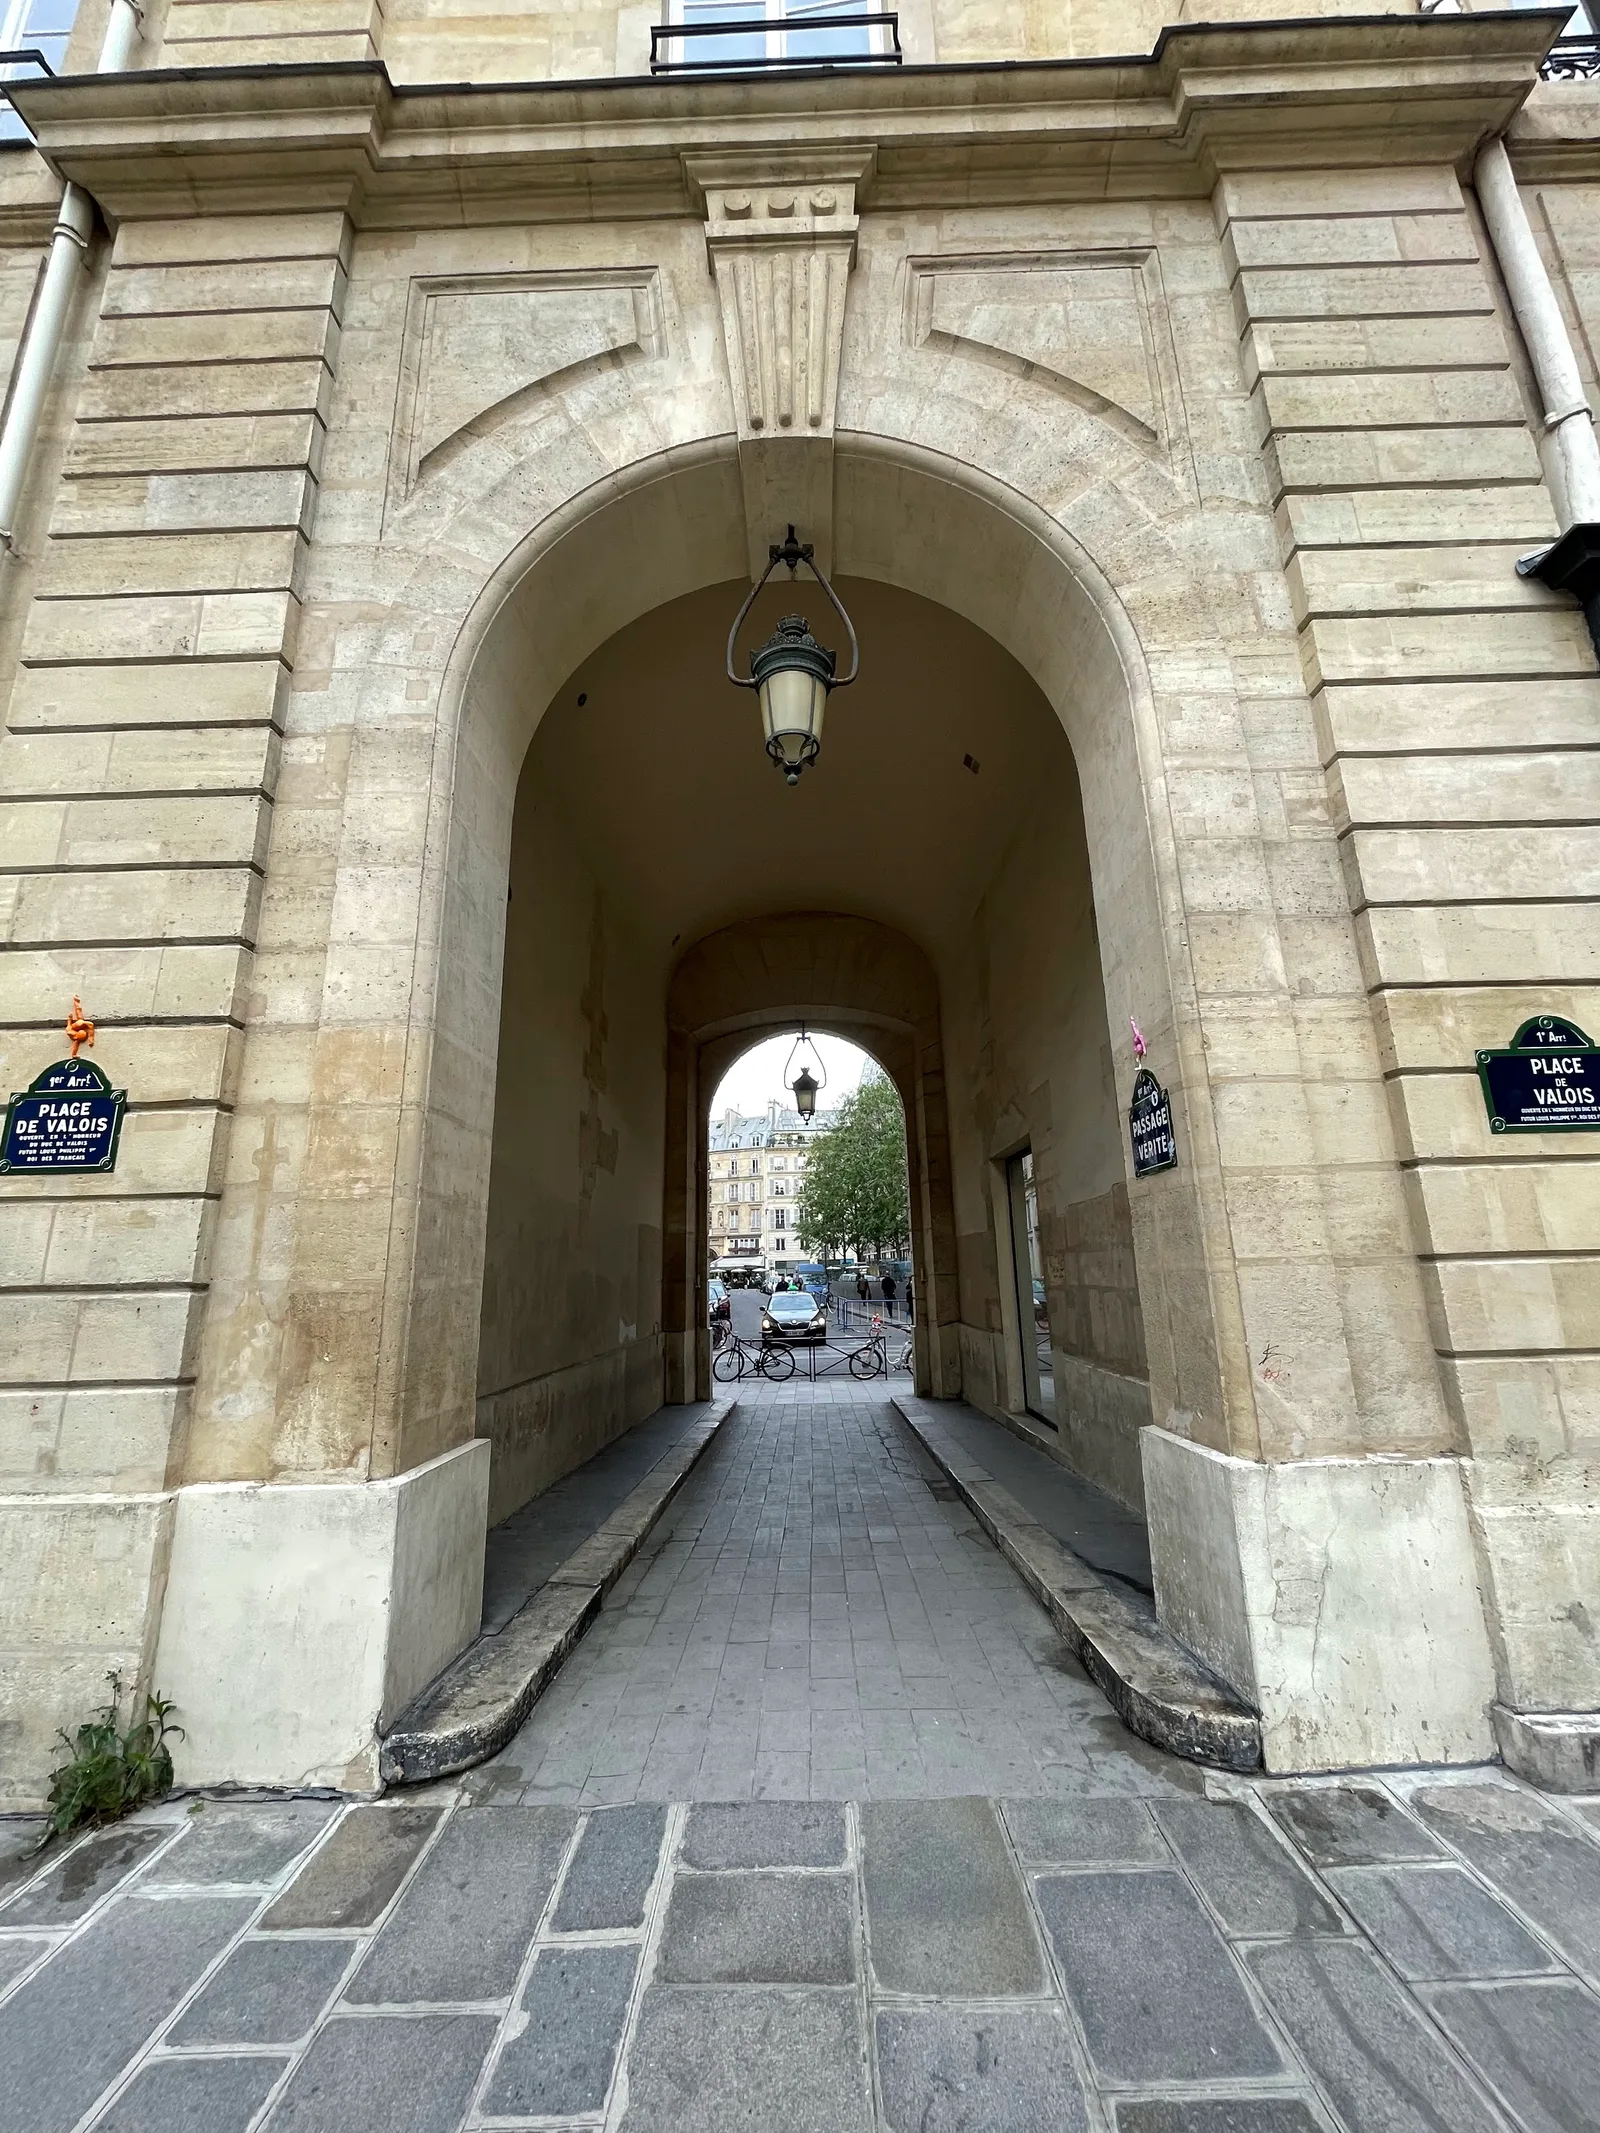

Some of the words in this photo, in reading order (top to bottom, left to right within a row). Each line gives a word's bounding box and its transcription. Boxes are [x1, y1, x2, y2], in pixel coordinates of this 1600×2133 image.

[1530, 1058, 1584, 1074] PLACE
[49, 1076, 64, 1088] 1er
[1555, 1078, 1567, 1087] DE
[1533, 1088, 1595, 1104] VALOIS
[16, 1120, 39, 1134] DE
[47, 1117, 108, 1133] VALOIS
[1132, 1107, 1167, 1138] PASSAGE
